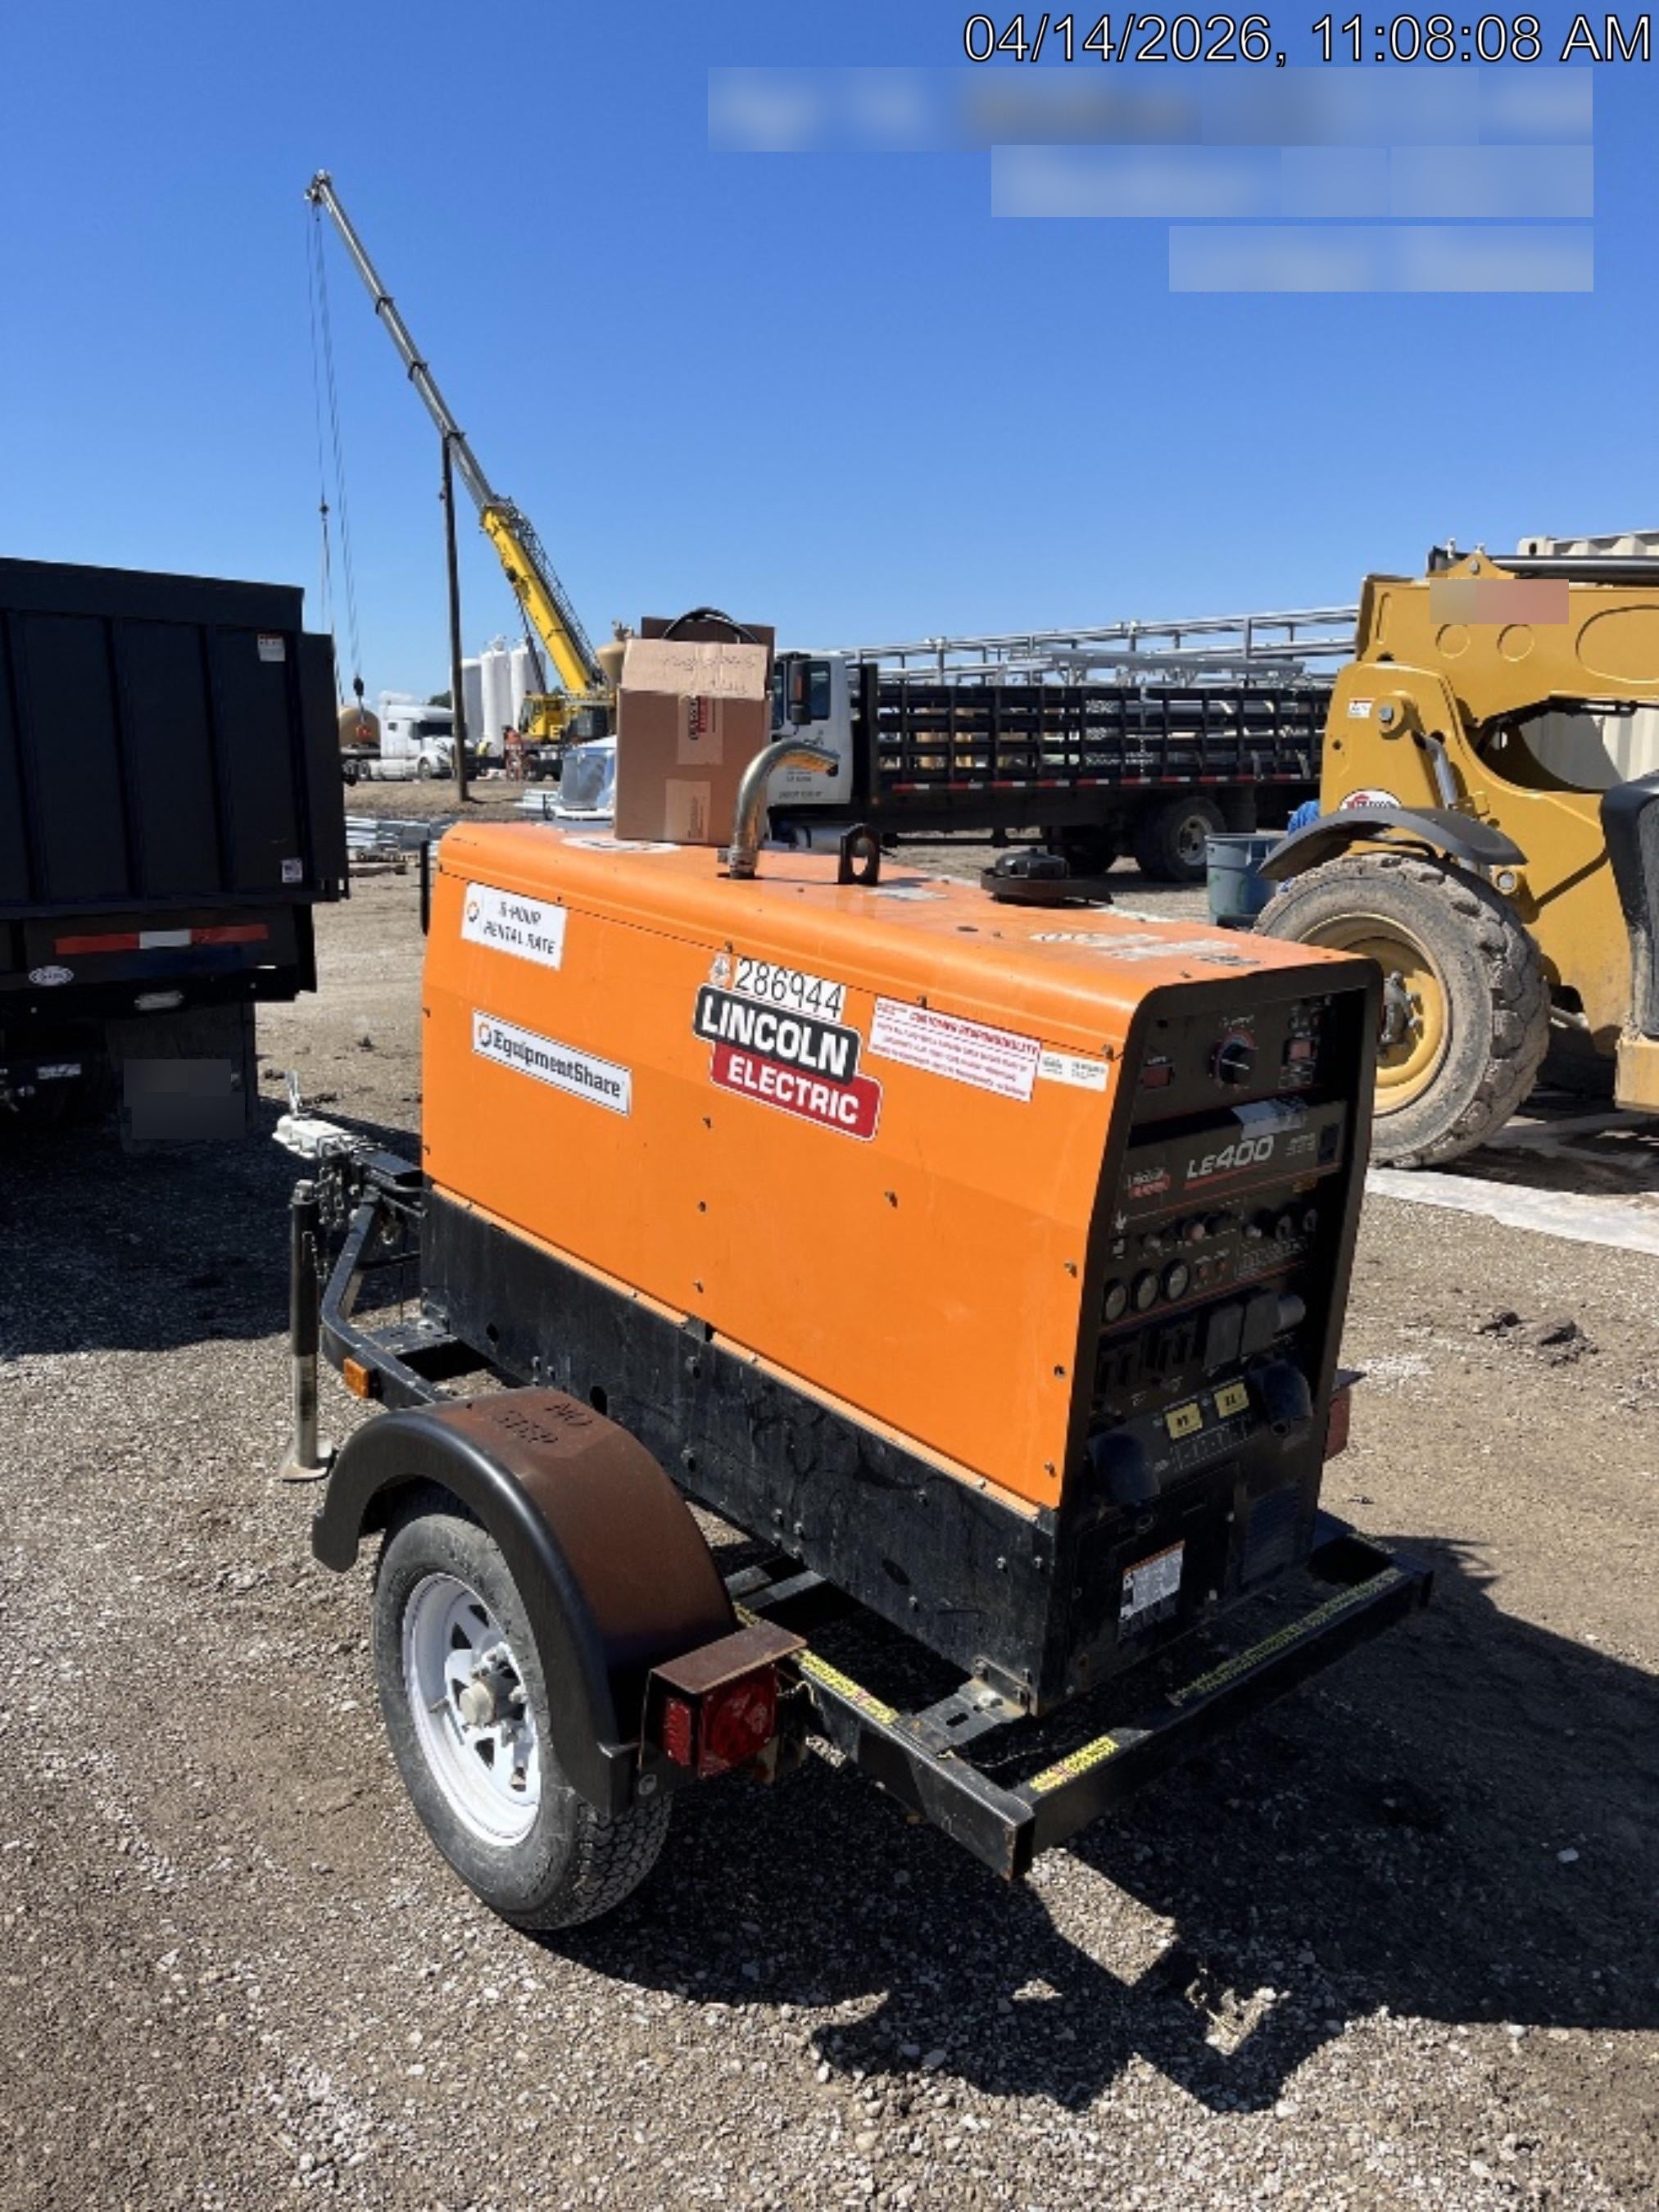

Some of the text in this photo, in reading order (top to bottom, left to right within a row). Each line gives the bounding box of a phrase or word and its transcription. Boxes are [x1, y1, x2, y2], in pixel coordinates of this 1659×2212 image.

[735, 956, 842, 1018] 286944
[492, 1028, 621, 1099] EquipmentShare
[700, 995, 850, 1078] LINCOLN
[727, 1054, 859, 1125] ELECTRIC
[1186, 1135, 1275, 1179] LE400
